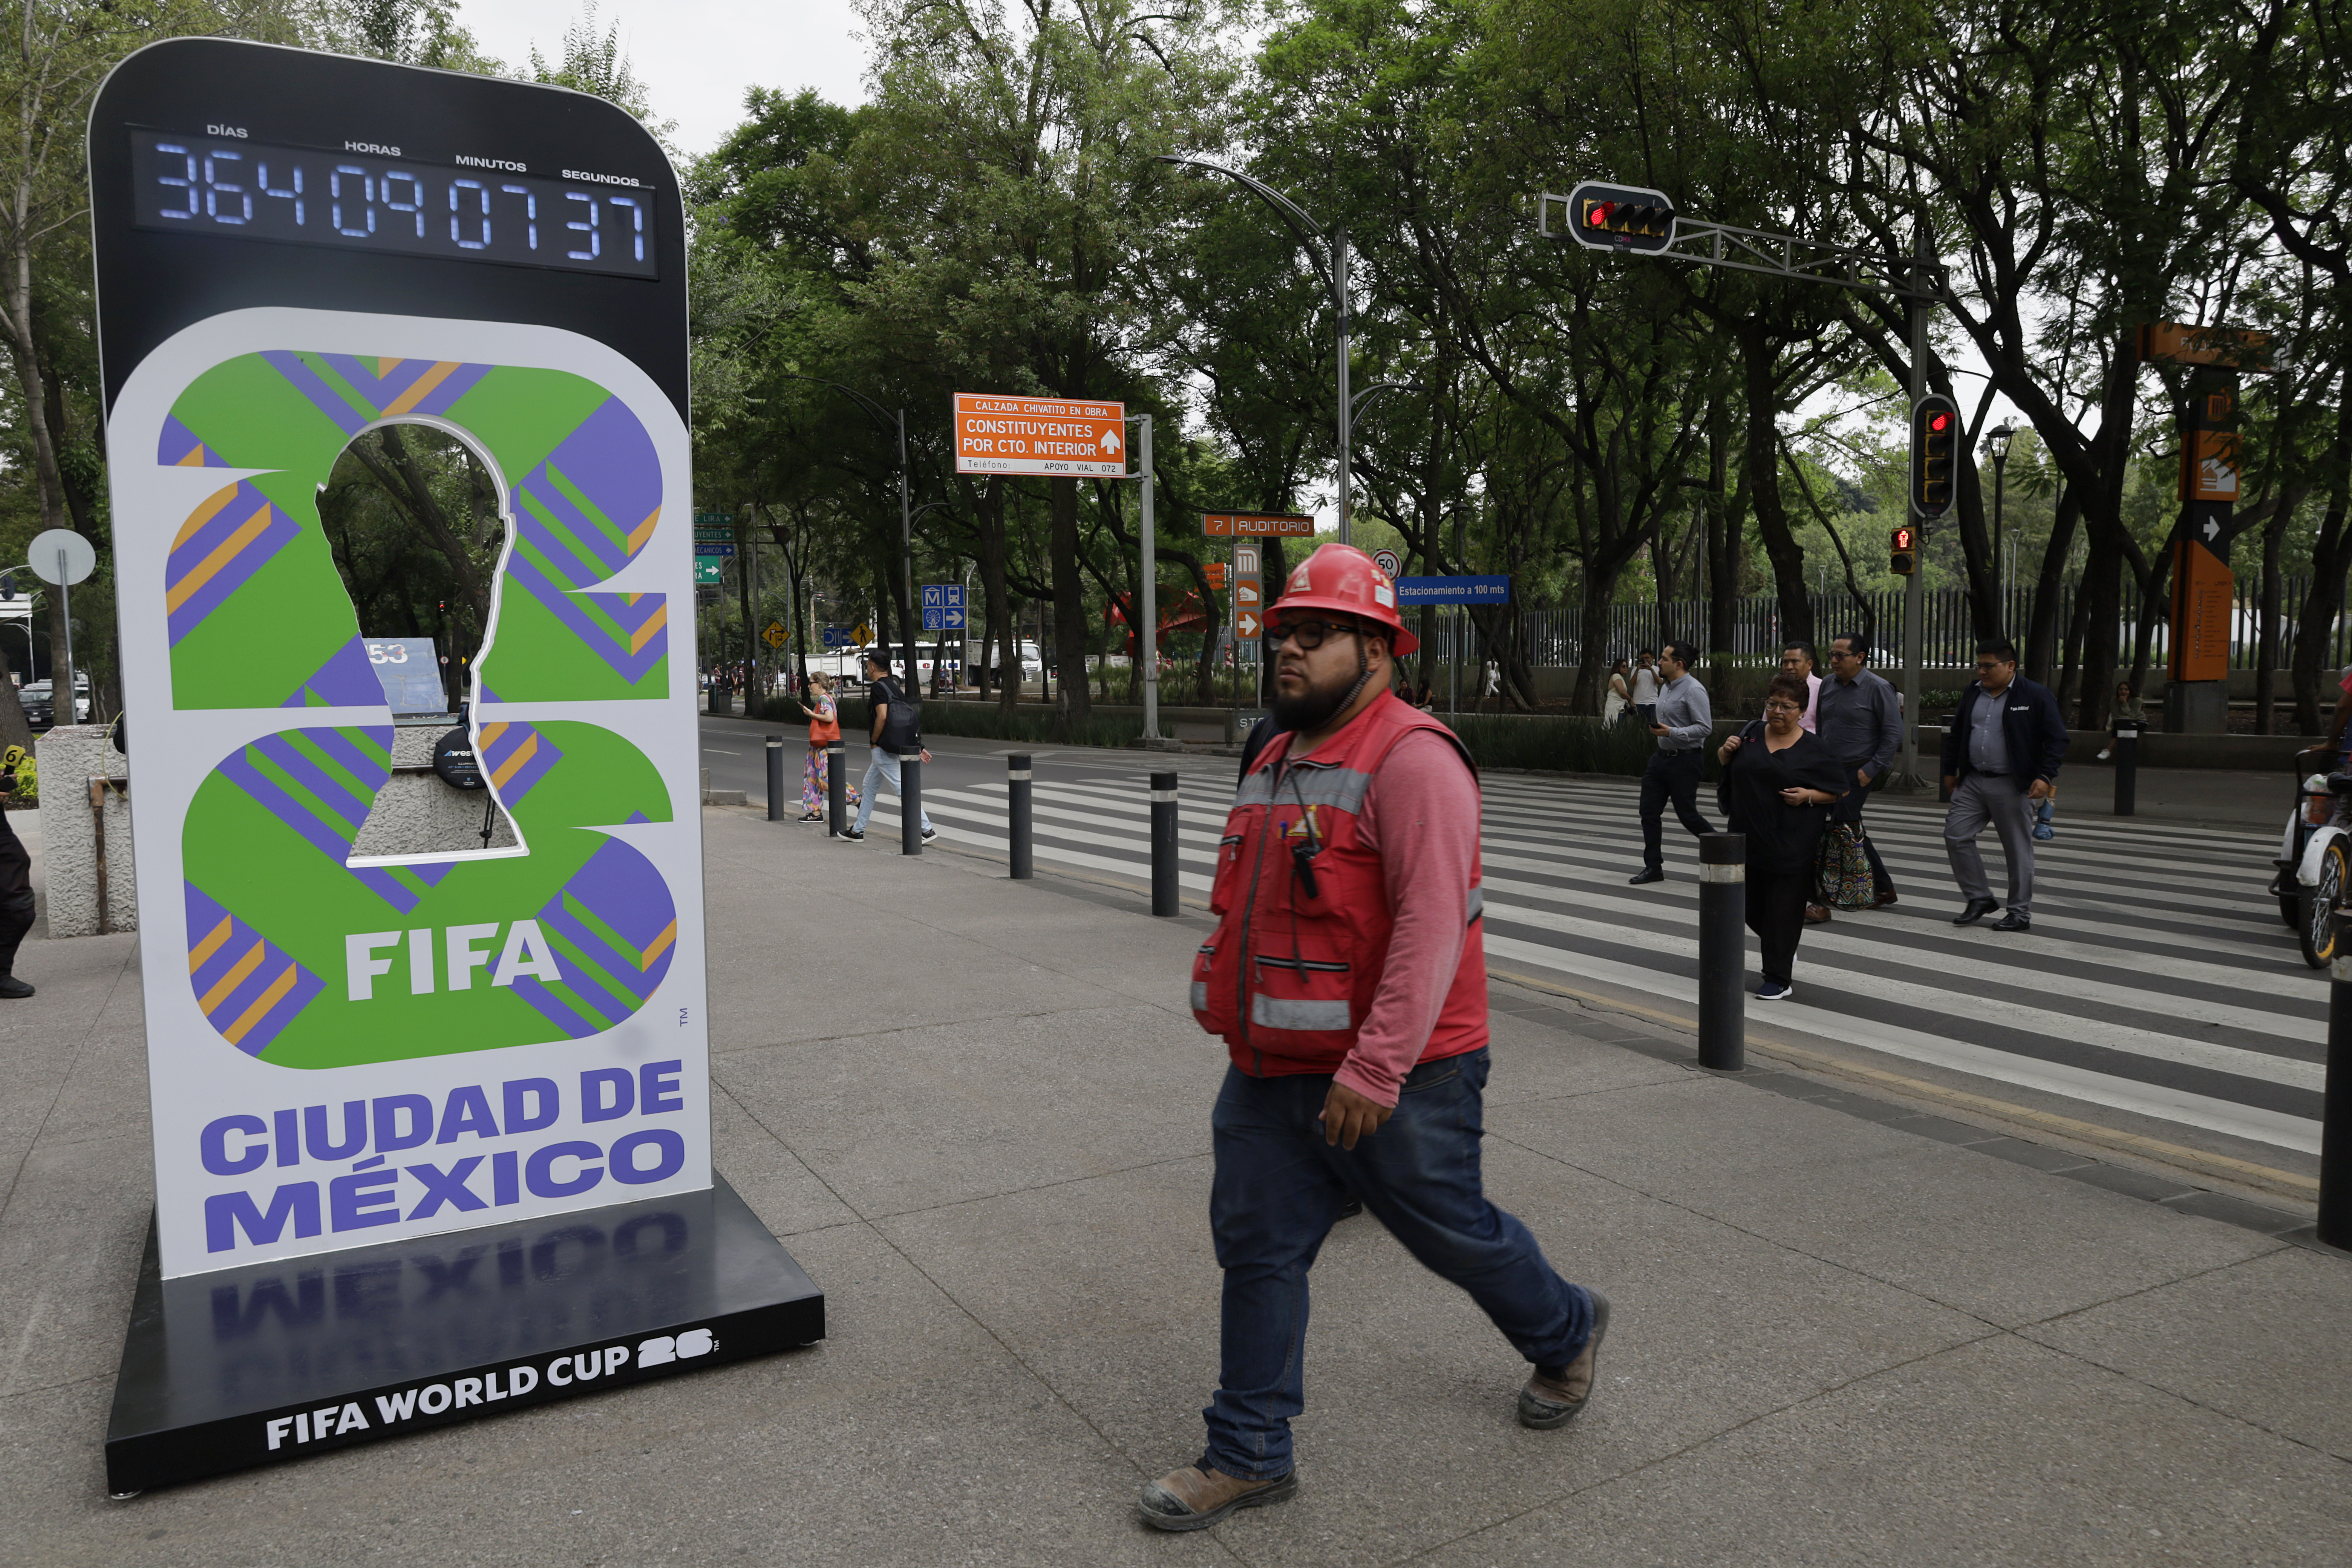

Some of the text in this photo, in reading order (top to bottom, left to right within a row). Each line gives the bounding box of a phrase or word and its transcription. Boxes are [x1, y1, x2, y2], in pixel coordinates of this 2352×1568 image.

[207, 124, 640, 187] DÍAS HORAS MINUTOS SEGUNDOS
[156, 144, 644, 262] 364 09 07 37
[975, 401, 1107, 416] CALZADA CHIVATITO EN OBRA
[966, 419, 1093, 438] CONSTITUYENTES
[963, 438, 1096, 456] POR CTO. INTERIOR
[968, 460, 1011, 469] Teléfono:
[1044, 462, 1069, 471] APOYO
[1214, 520, 1309, 532] 7 AUDITORIO
[1378, 559, 1393, 570] 50
[1399, 585, 1465, 596] Estacionamiento
[1474, 585, 1488, 594] 100
[1490, 585, 1505, 594] mts
[6, 750, 17, 762] 6
[345, 919, 563, 1002] FIFA
[679, 1007, 688, 1027] TM
[200, 1060, 683, 1176] CIUDAD DE
[204, 1129, 685, 1254] MÉXICO
[266, 1402, 370, 1450] FIFA
[375, 1366, 539, 1424] WORLD
[547, 1346, 630, 1386] CUP
[637, 1328, 713, 1369] 26
